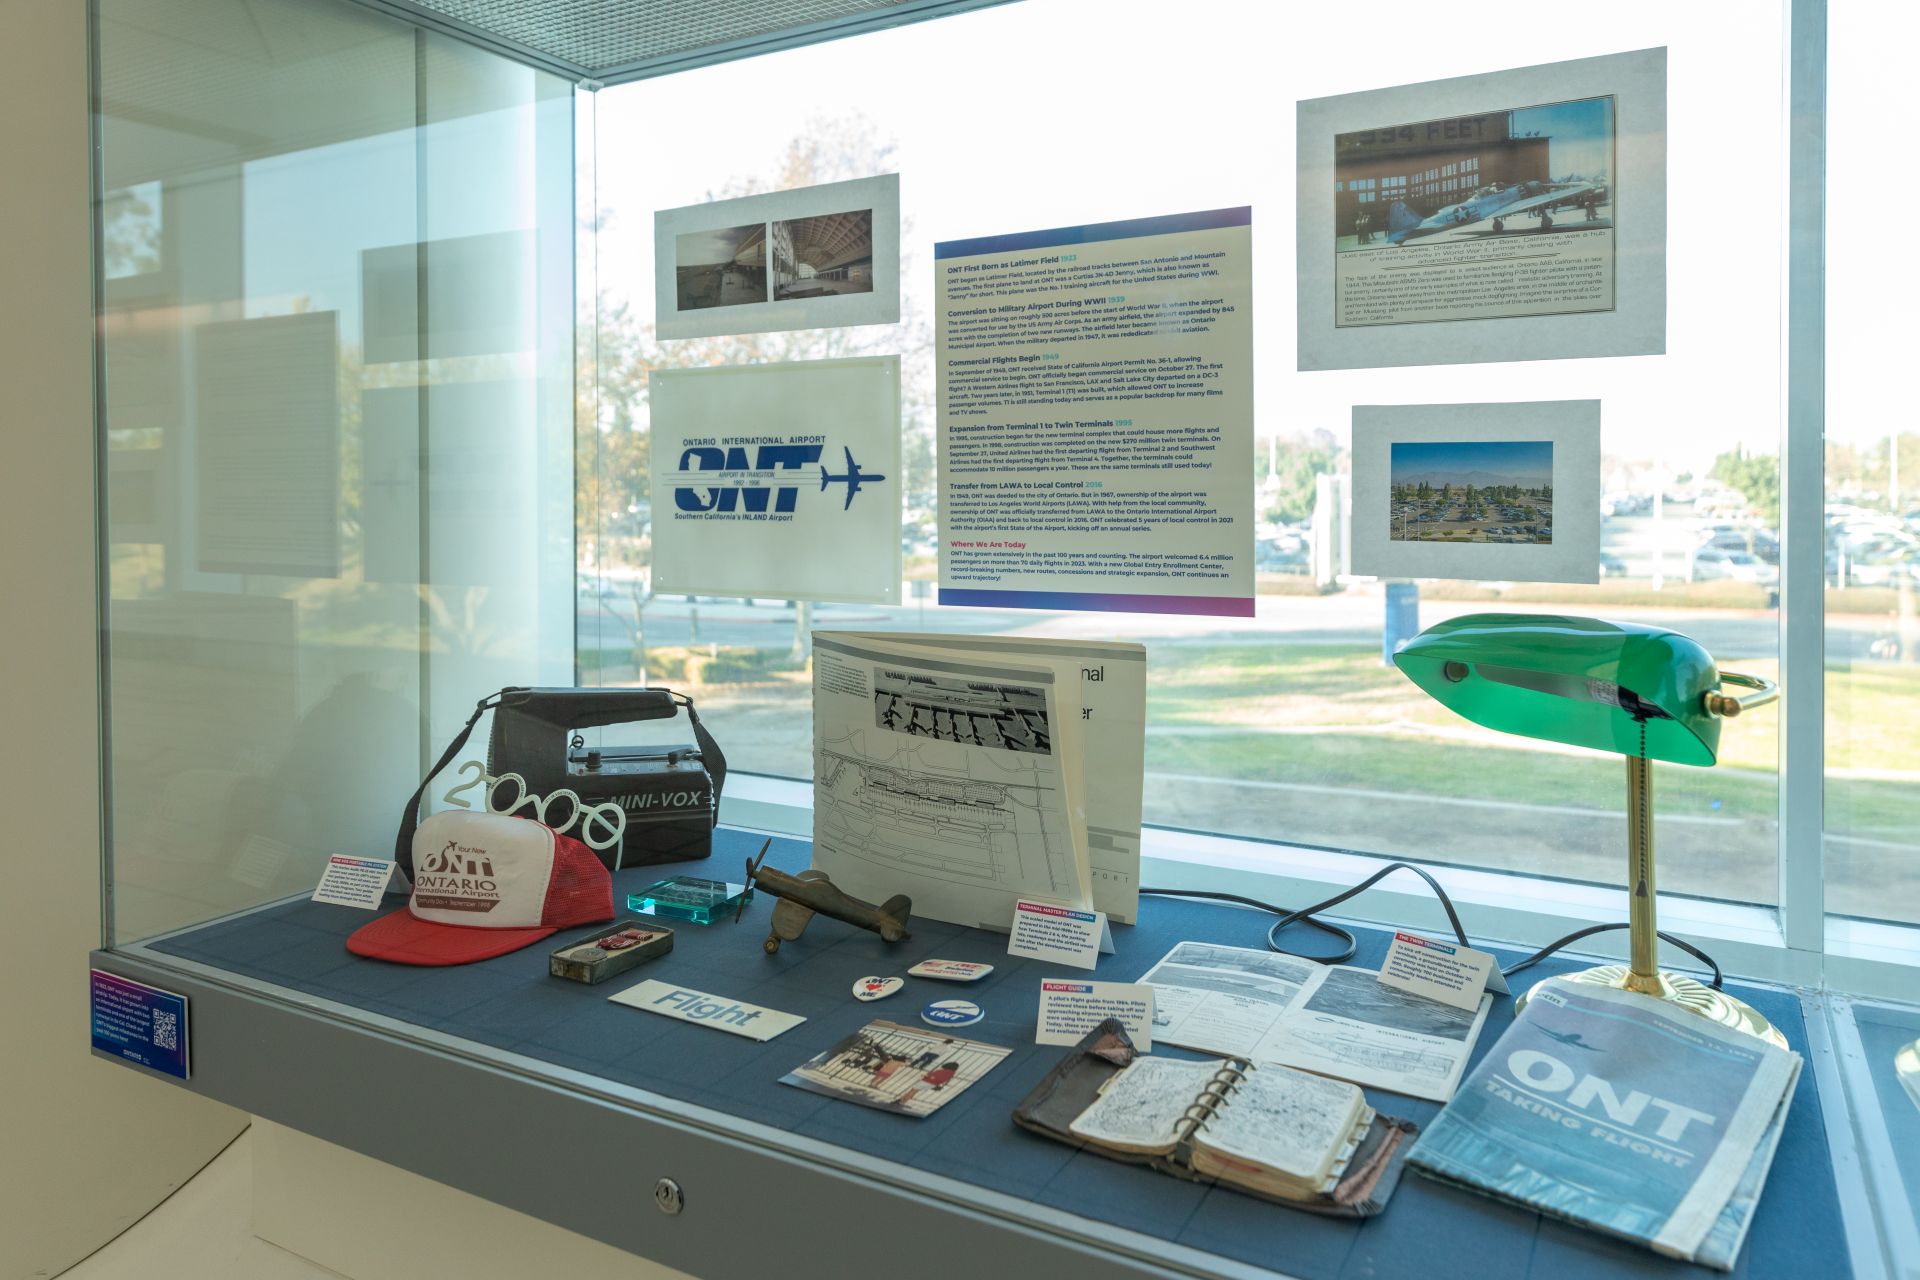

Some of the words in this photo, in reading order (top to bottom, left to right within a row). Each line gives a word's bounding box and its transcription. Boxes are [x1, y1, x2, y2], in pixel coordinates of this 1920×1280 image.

[1427, 117, 1487, 140] FEET
[947, 266, 962, 274] ONT
[963, 264, 979, 272] First
[981, 262, 999, 270] Born
[1010, 258, 1038, 267] Latimer
[1040, 256, 1059, 264] Field
[947, 307, 987, 317] Conversion
[997, 304, 1025, 314] Military
[1027, 301, 1054, 312] Airport
[1055, 299, 1082, 309] During
[1083, 297, 1106, 305] WWII
[948, 357, 991, 366] Commercial
[991, 355, 1017, 365] Flights
[1018, 354, 1040, 363] Begin
[948, 424, 985, 434] Expansion
[1006, 422, 1038, 430] Terminal
[1075, 419, 1113, 428] Terminals
[683, 438, 716, 446] ONTARIO
[722, 436, 784, 445] INTERNATIONAL
[789, 435, 826, 444] AIRPORT
[675, 445, 823, 512] ONT
[704, 513, 741, 521] California's
[742, 513, 767, 521] INLAND
[769, 514, 793, 522] Airport
[1004, 541, 1026, 549] Today
[1082, 665, 1104, 682] nal
[611, 791, 702, 809] MINI-VOX
[458, 845, 471, 853] Your
[416, 876, 496, 891] ONTARIO
[461, 889, 500, 898] Airport
[1019, 904, 1042, 912] TERMINAL
[1043, 906, 1061, 915] MASTER
[1410, 937, 1423, 945] TWIN
[1424, 941, 1453, 953] TERMINALS
[652, 990, 762, 1027] Flight
[1507, 1050, 1717, 1142] ONT
[1485, 1080, 1582, 1129] TAKING
[1590, 1128, 1692, 1168] FLIGHT
